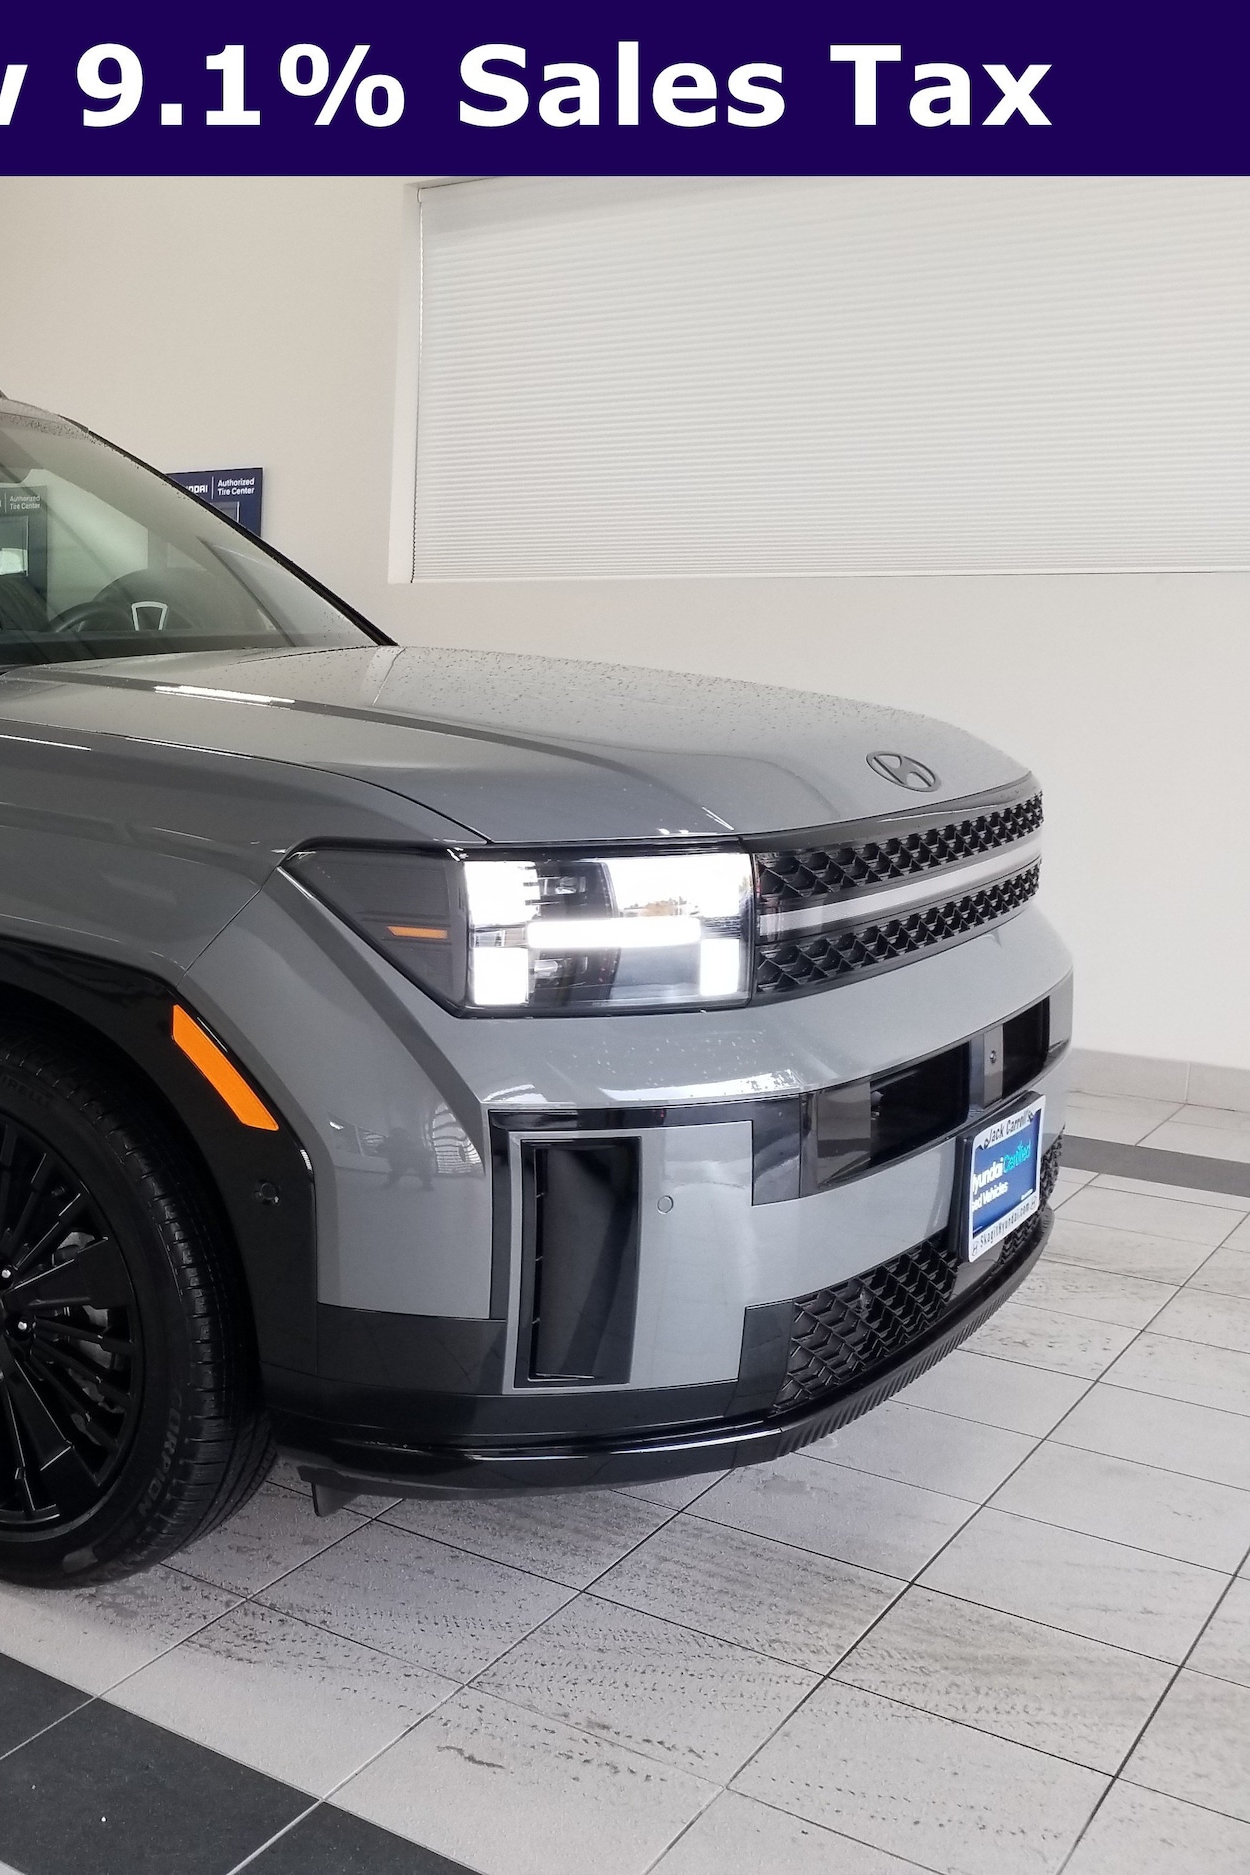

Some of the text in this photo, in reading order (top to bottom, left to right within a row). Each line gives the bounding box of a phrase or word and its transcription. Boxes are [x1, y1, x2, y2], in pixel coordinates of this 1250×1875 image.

[217, 477, 255, 487] Authorized
[186, 484, 208, 494] NDAI
[217, 487, 255, 496] Tire Center
[989, 1123, 1005, 1142] Jack
